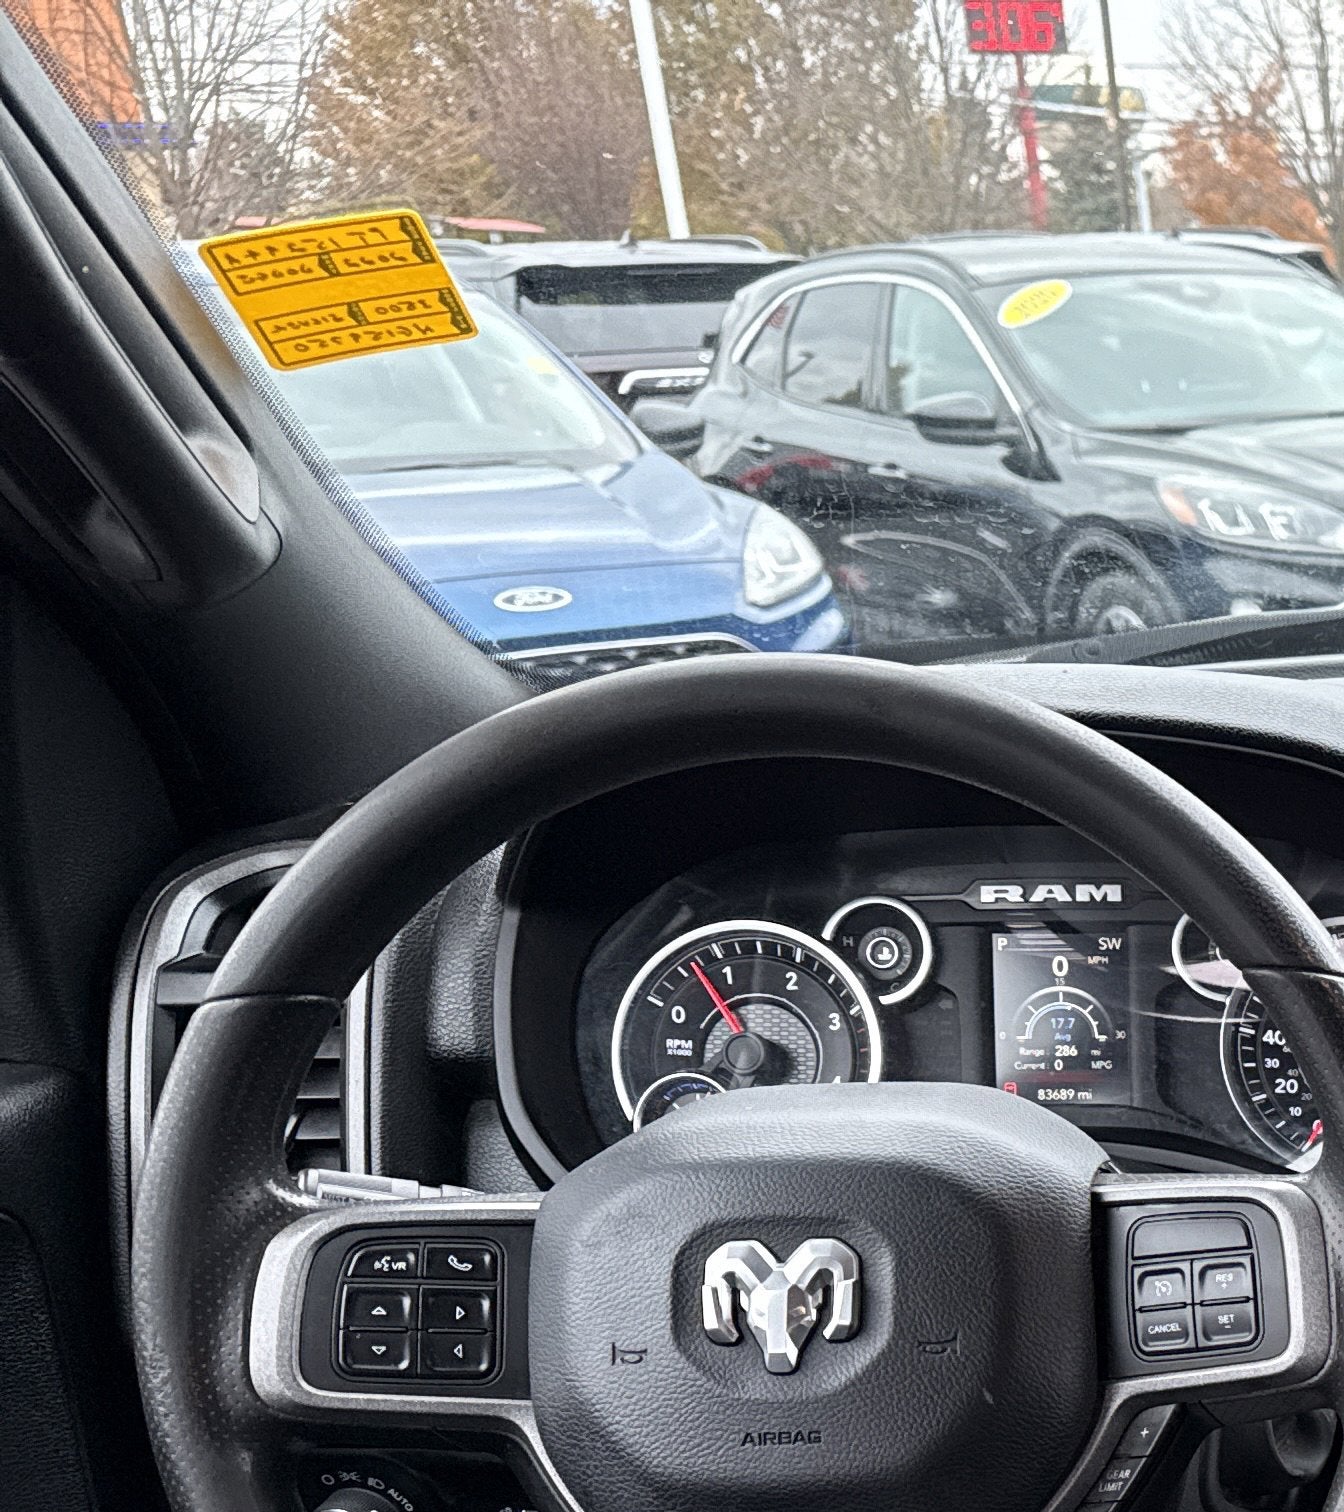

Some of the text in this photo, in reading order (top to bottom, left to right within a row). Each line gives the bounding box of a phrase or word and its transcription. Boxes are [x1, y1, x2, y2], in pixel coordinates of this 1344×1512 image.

[980, 884, 1122, 903] RAM
[842, 936, 854, 947] H
[1098, 938, 1122, 951] SW
[1052, 956, 1109, 978] 0 MPH
[722, 966, 733, 985] 1
[785, 972, 798, 990] 2
[671, 1006, 686, 1024] 0
[828, 1012, 841, 1031] 3
[1050, 1018, 1075, 1029] 17.7
[666, 1038, 693, 1050] RPM
[1055, 1045, 1078, 1057] 286
[1054, 1060, 1064, 1070] 0
[1091, 1060, 1113, 1070] MPG
[1264, 1058, 1280, 1069] 30
[1274, 1079, 1298, 1094] 20
[1037, 1089, 1093, 1101] 83689 mi
[1289, 1106, 1302, 1117] 10
[391, 1260, 407, 1271] VR
[1218, 1313, 1235, 1325] SET
[1148, 1322, 1182, 1335] CANCEL
[740, 1430, 822, 1447] AIRBAG
[1098, 1481, 1124, 1493] LIMIT
[387, 1488, 414, 1512] AUTO
